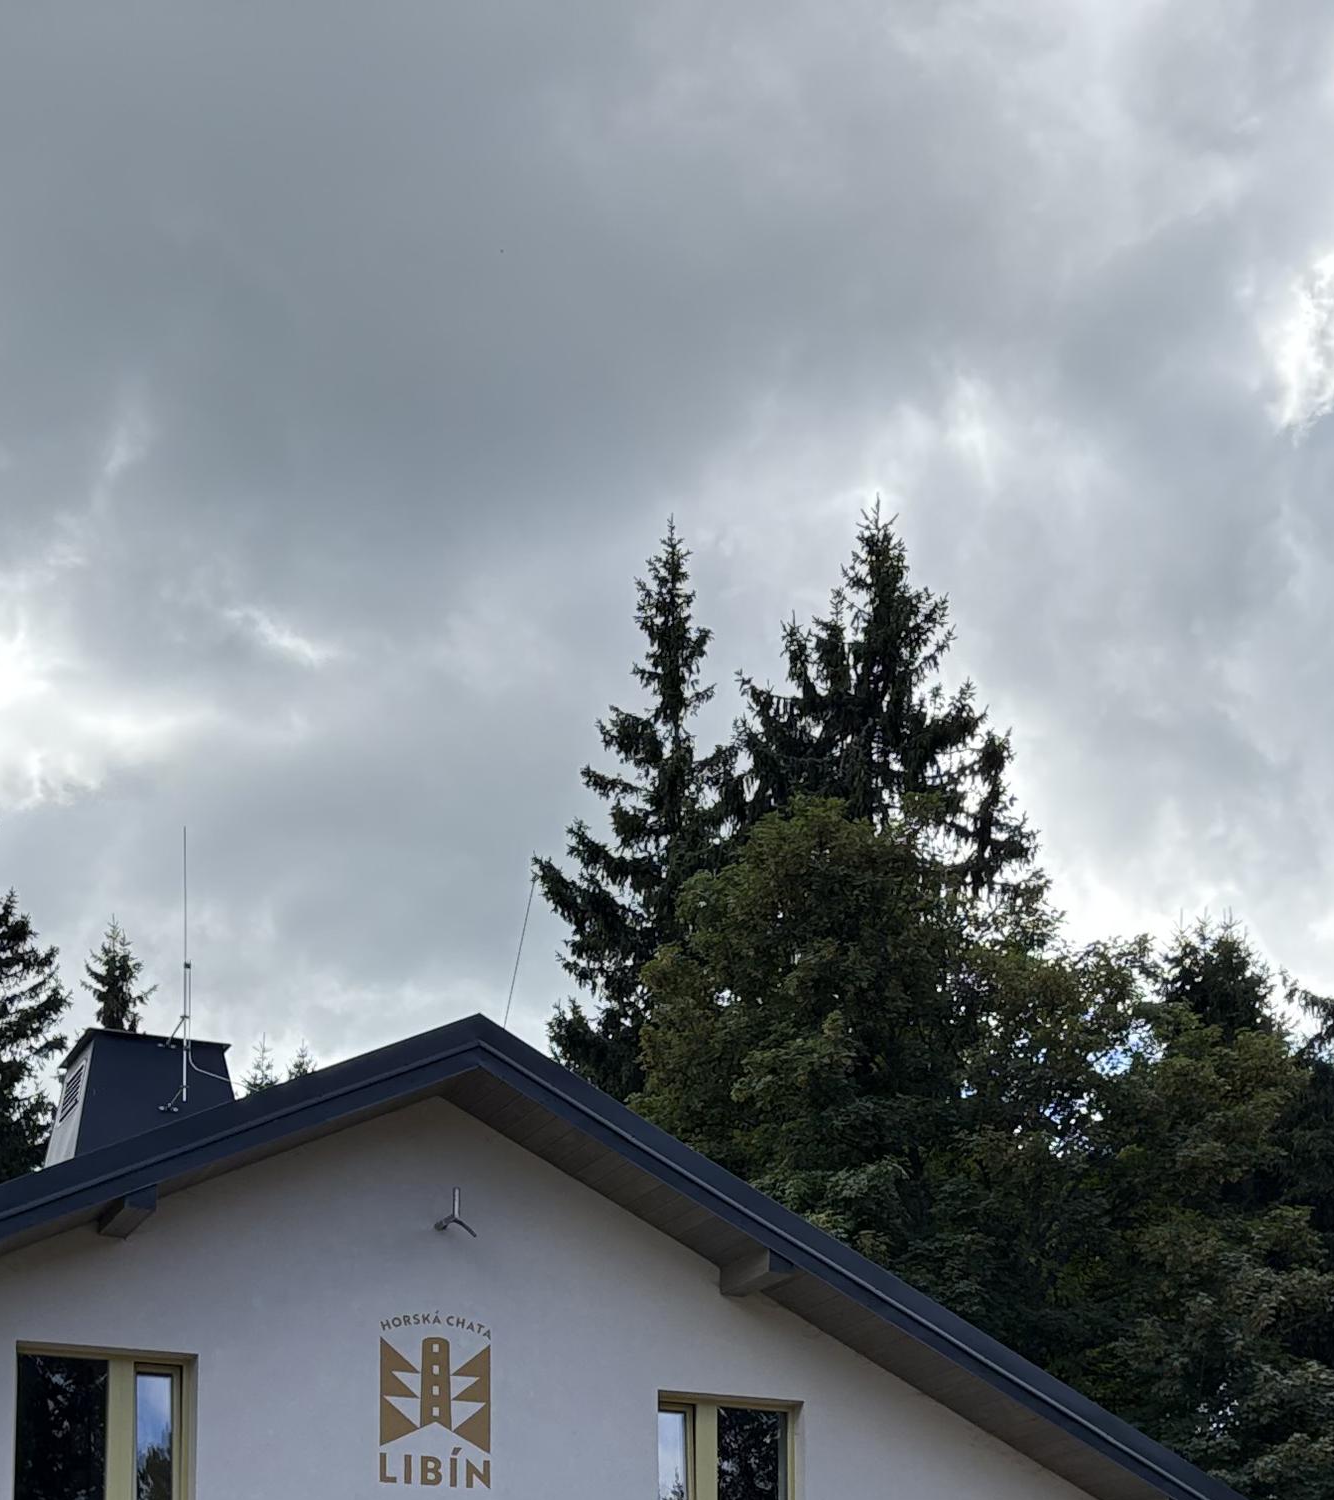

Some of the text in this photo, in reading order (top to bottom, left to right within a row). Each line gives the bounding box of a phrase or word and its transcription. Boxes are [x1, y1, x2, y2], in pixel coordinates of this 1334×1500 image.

[380, 1310, 492, 1341] HORSKÁ CHATA
[379, 1447, 491, 1490] LIBÍN
